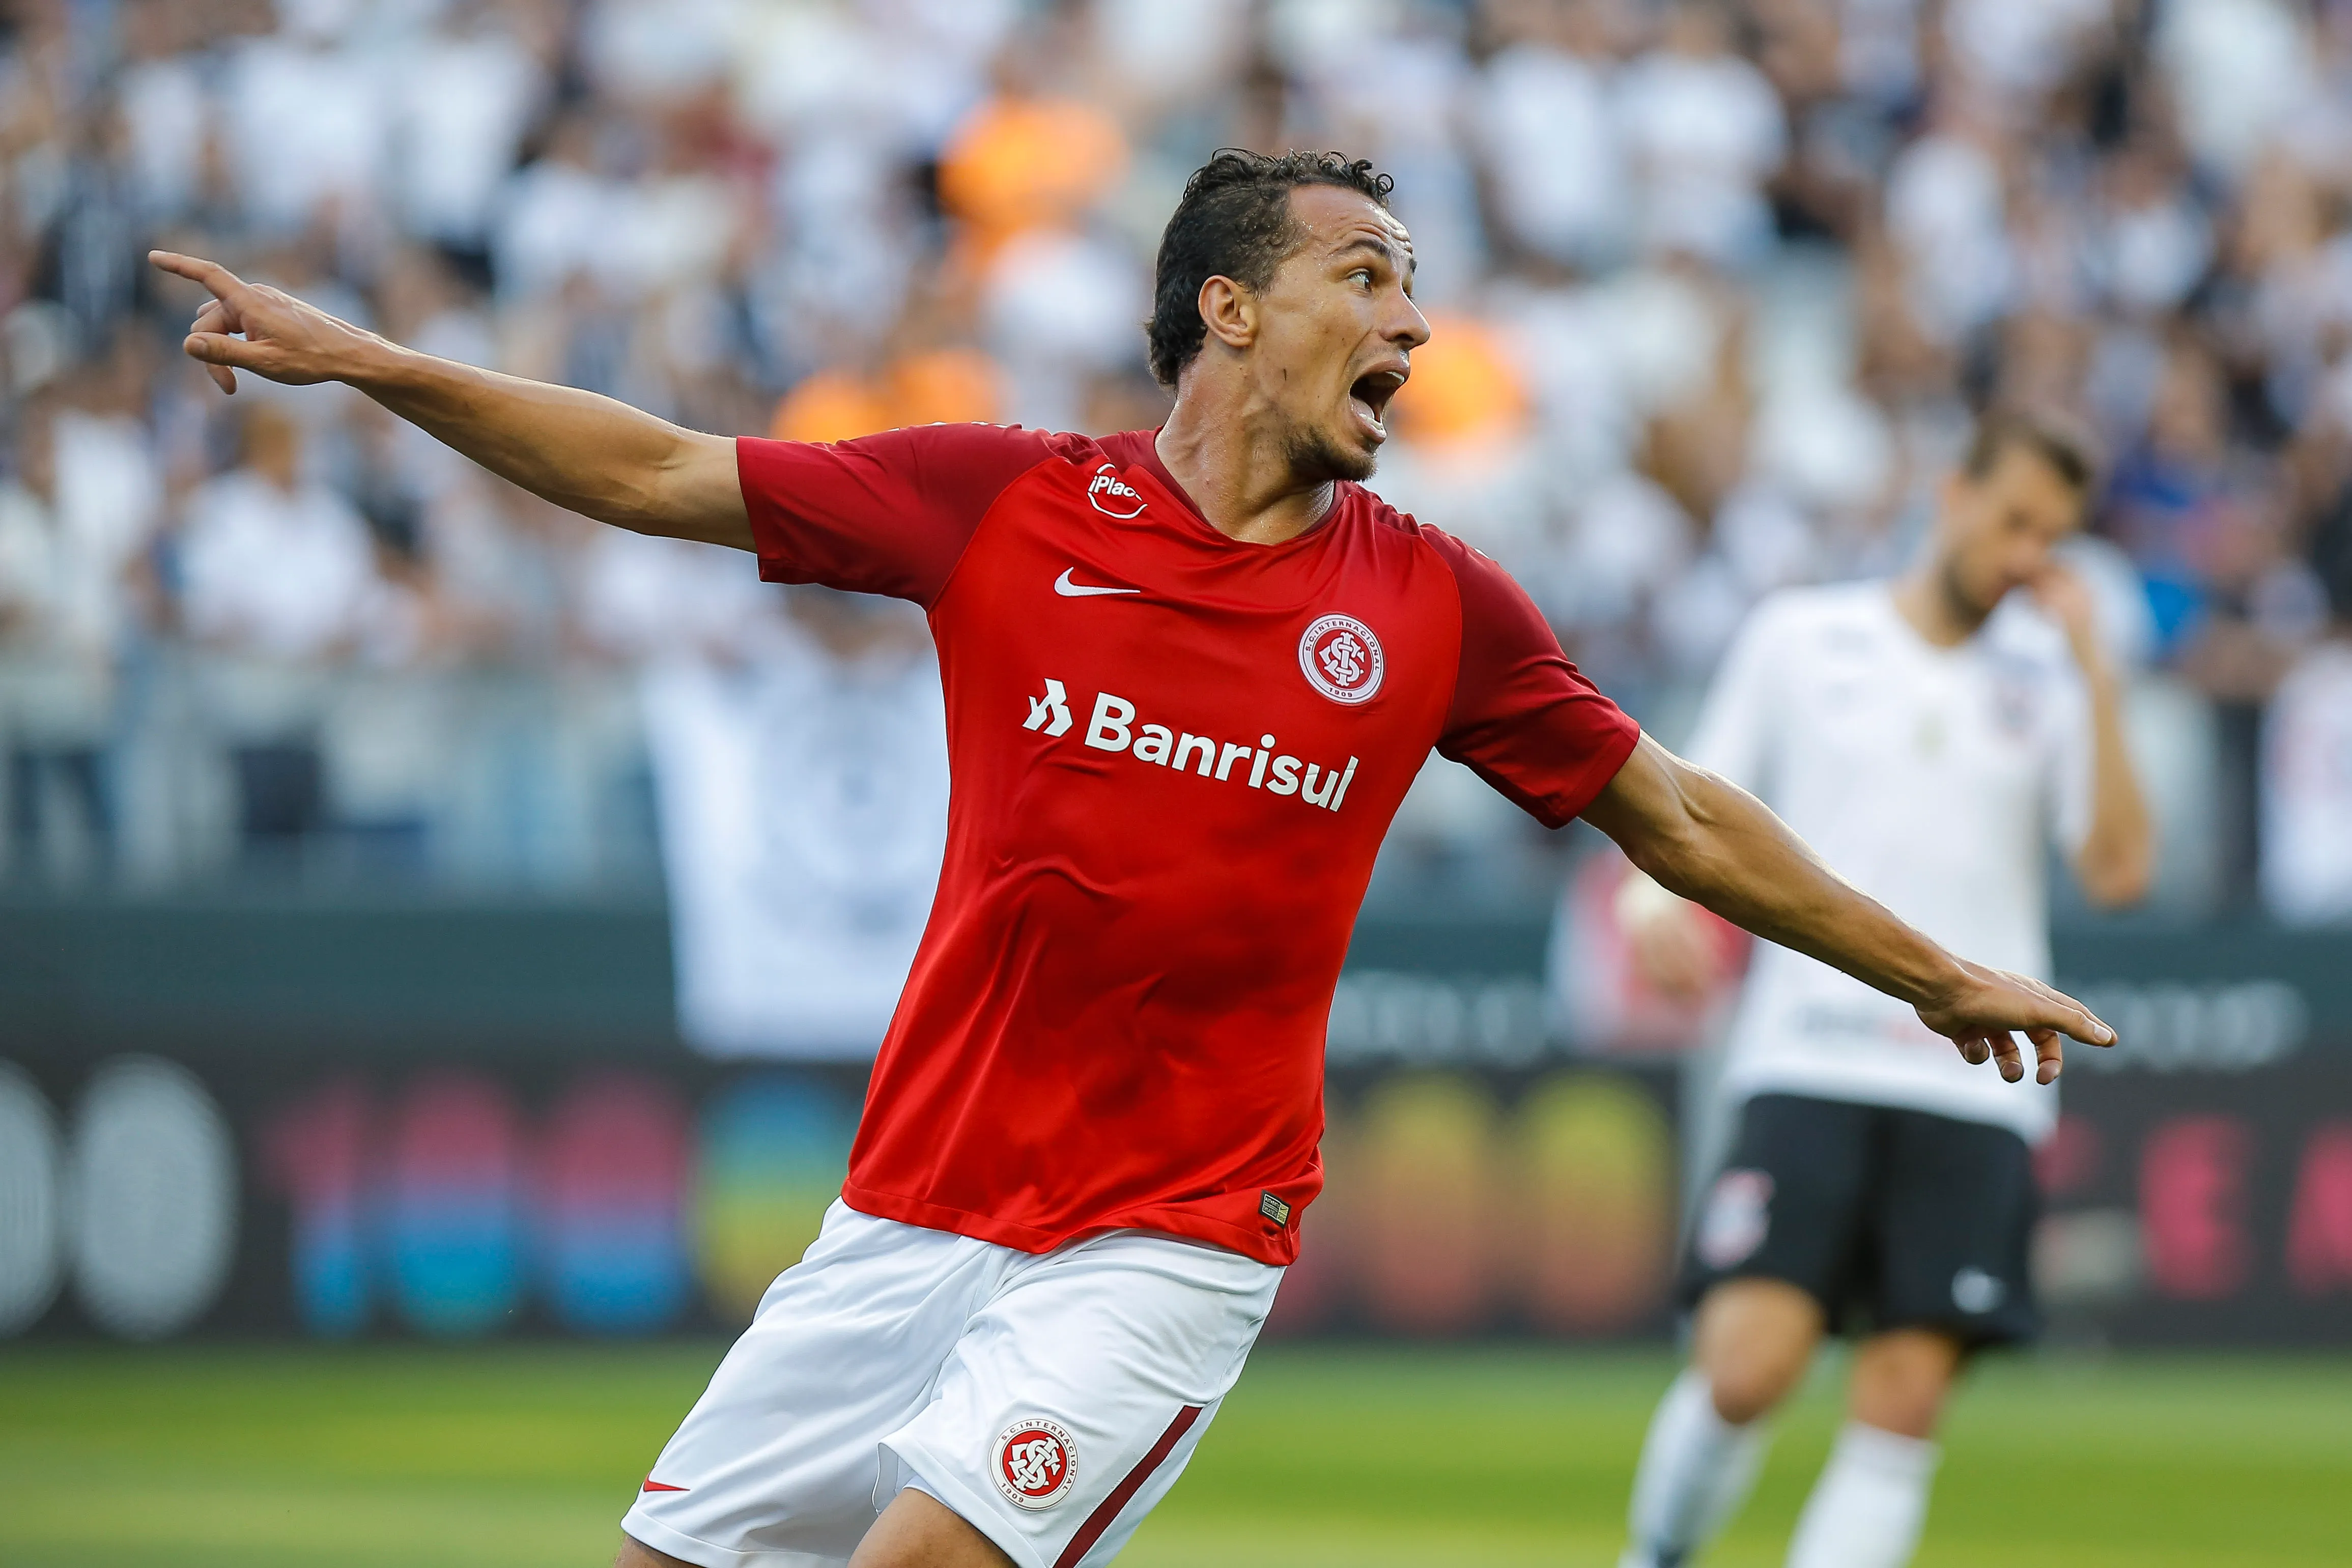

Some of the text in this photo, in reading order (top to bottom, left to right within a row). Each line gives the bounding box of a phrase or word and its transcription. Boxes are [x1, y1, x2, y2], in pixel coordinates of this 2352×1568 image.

[1329, 687, 1353, 697] 1909
[1084, 692, 1359, 812] Banrisul
[1001, 1483, 1024, 1502] 1909
